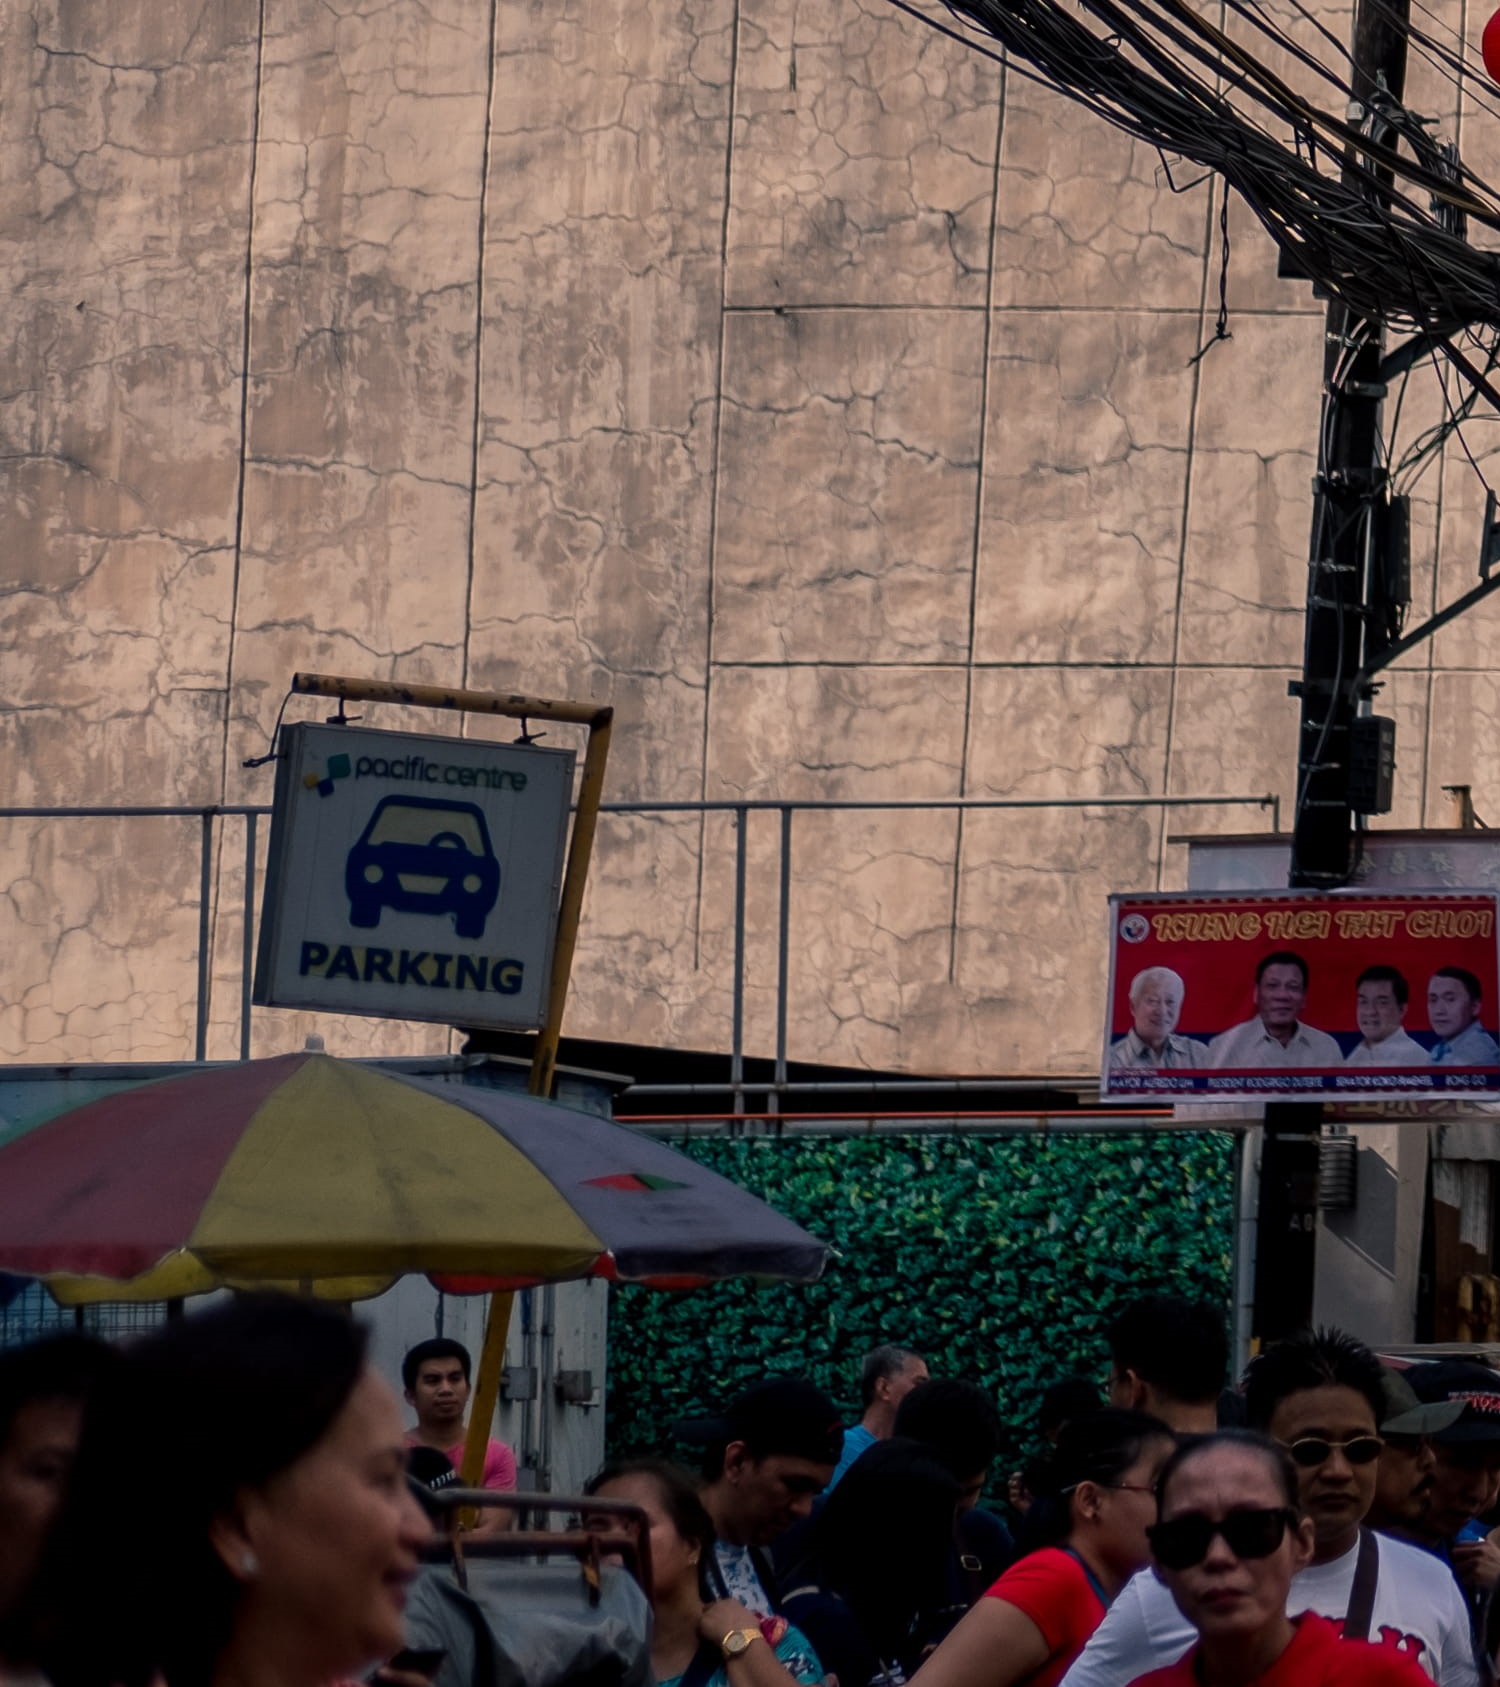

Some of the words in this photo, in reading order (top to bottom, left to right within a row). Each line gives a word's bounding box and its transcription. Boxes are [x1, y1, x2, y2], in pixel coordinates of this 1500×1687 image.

[355, 754, 439, 782] pacific
[444, 765, 528, 792] centre
[1152, 911, 1262, 943] KUNG
[1263, 910, 1332, 940] HEI
[1333, 909, 1406, 940] FAT
[1405, 909, 1494, 939] CHOI
[299, 941, 524, 995] PARKING
